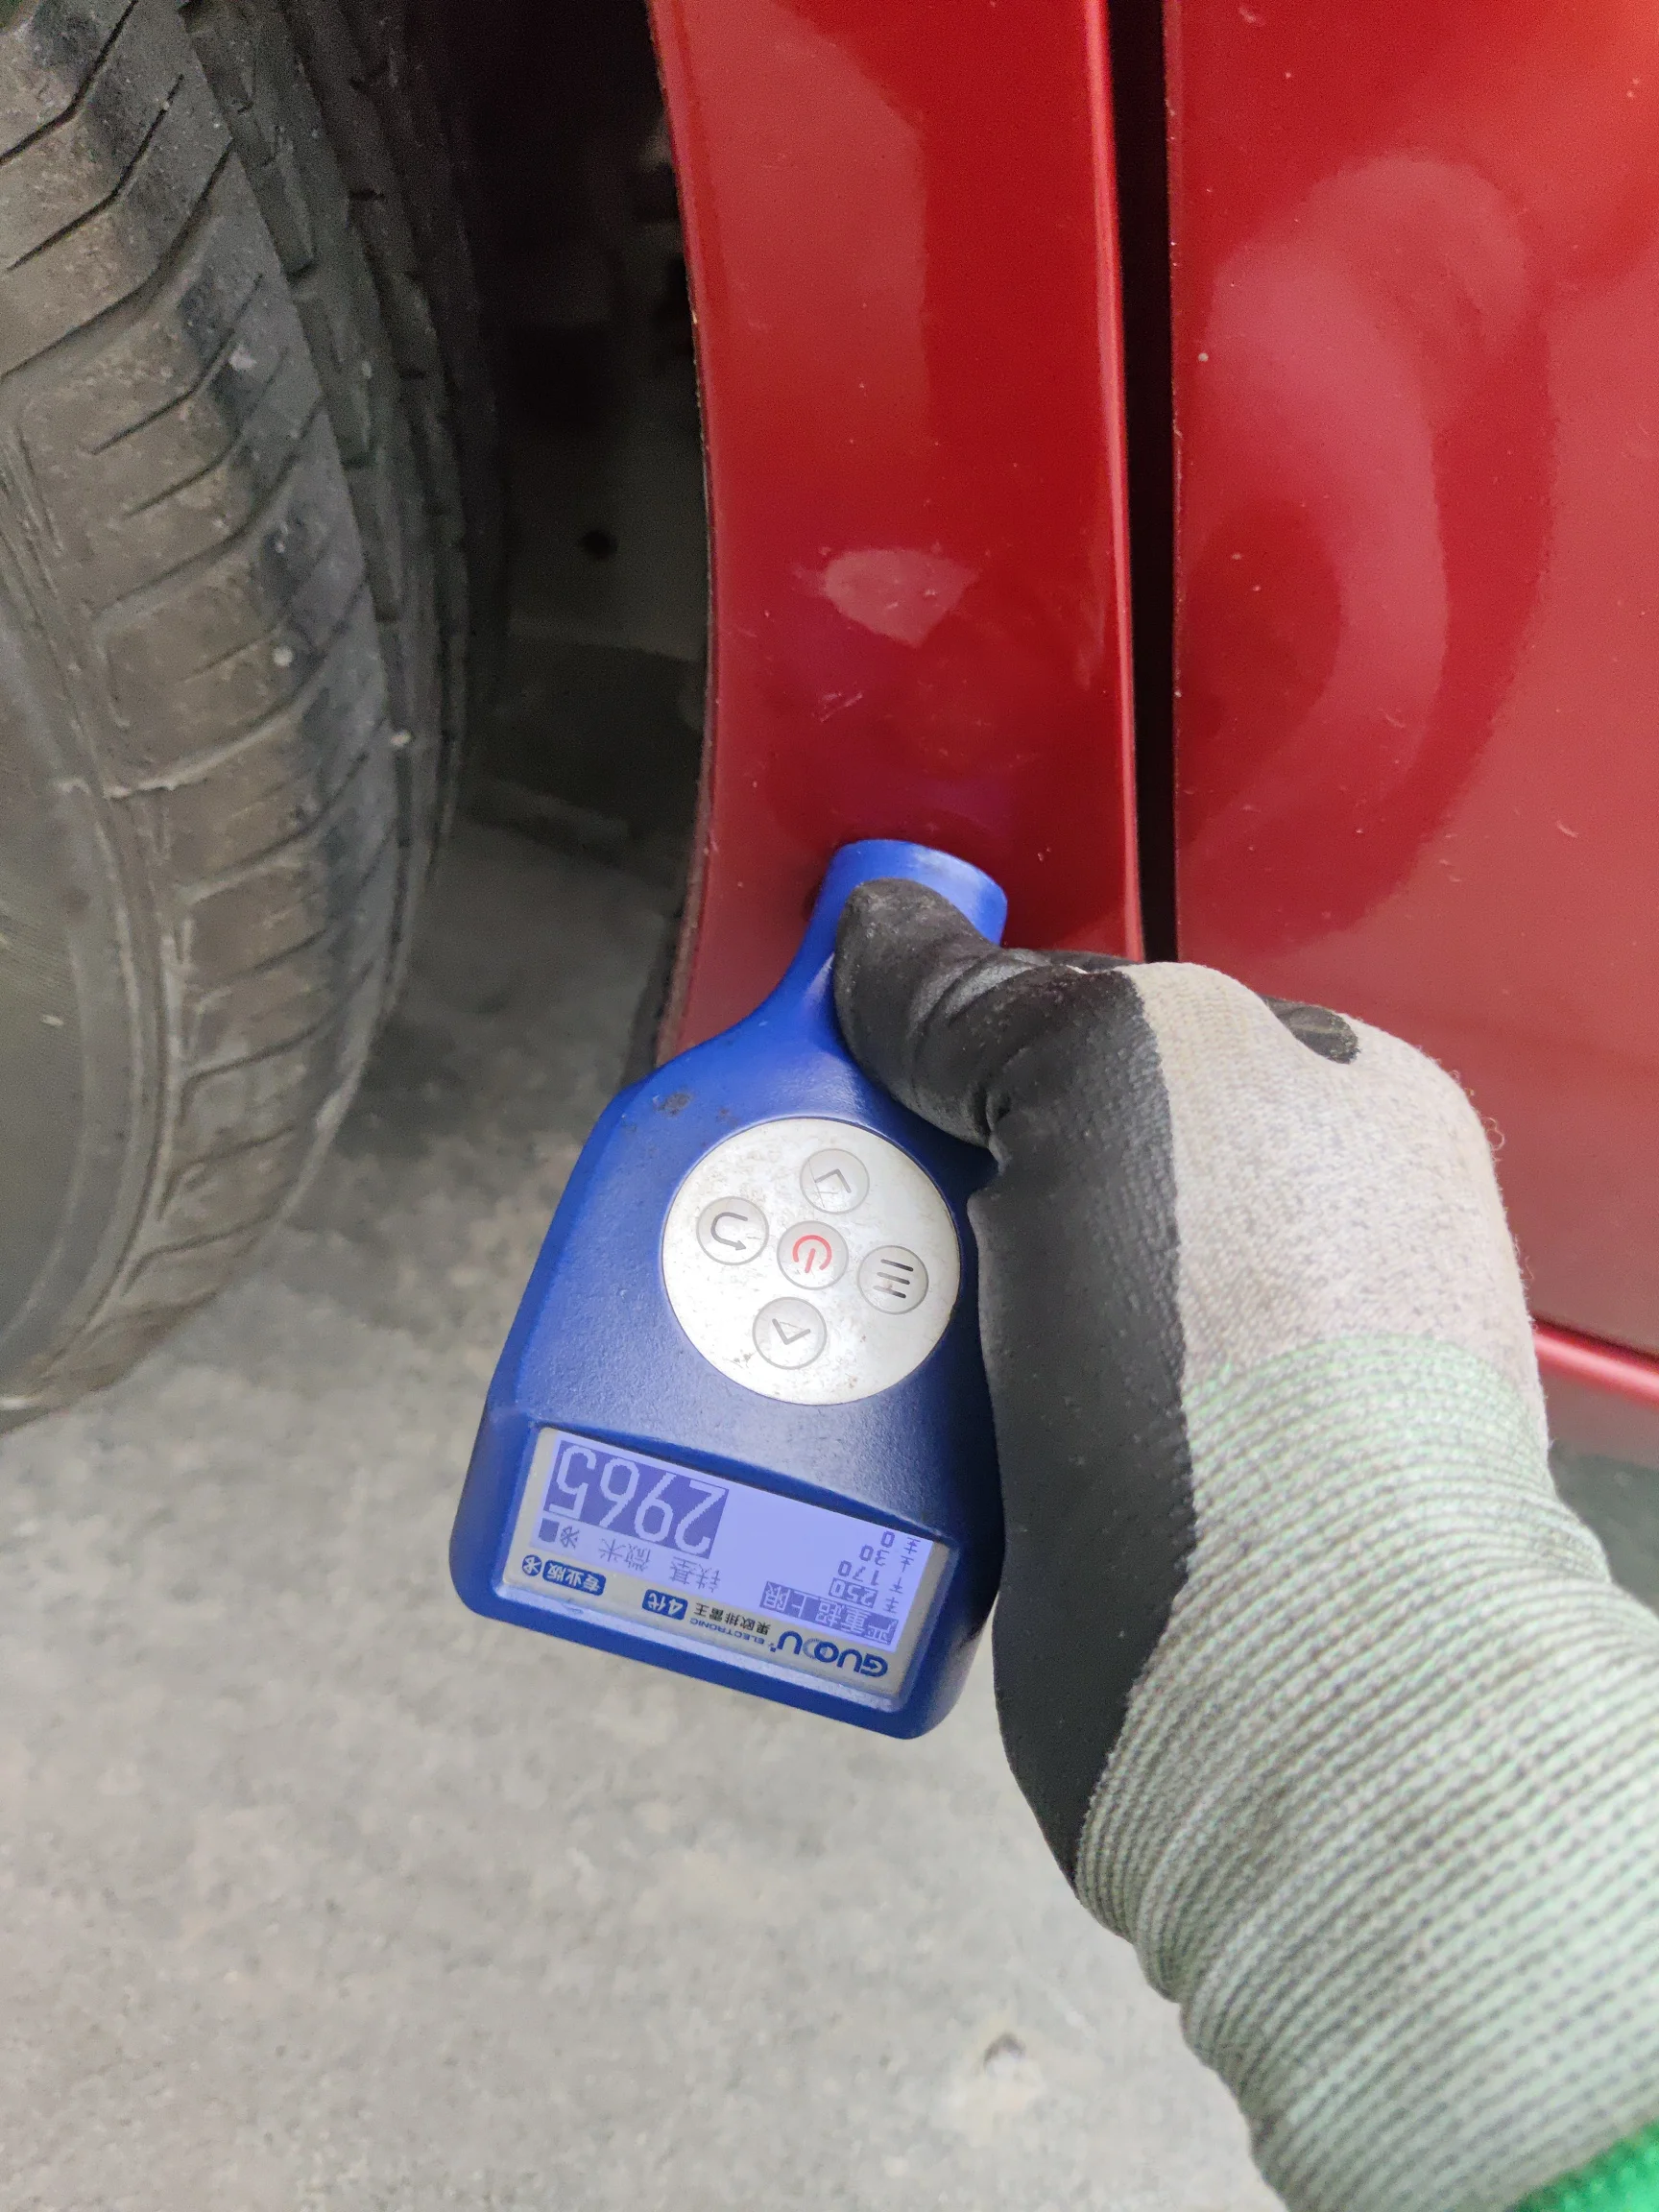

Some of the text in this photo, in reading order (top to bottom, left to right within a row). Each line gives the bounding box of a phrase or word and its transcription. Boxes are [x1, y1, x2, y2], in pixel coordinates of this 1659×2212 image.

[548, 1445, 726, 1555] 2965
[880, 1530, 896, 1548] 0
[597, 1538, 721, 1593] 铁基 微米
[859, 1545, 889, 1567] 30
[546, 1562, 602, 1592] 专业版
[838, 1560, 879, 1586] 170
[645, 1592, 684, 1618] 4代
[830, 1579, 877, 1606] 250
[693, 1602, 771, 1635] 果欧排雷王
[764, 1584, 896, 1644] 严重超上限
[689, 1618, 765, 1645] ELECTRONIC
